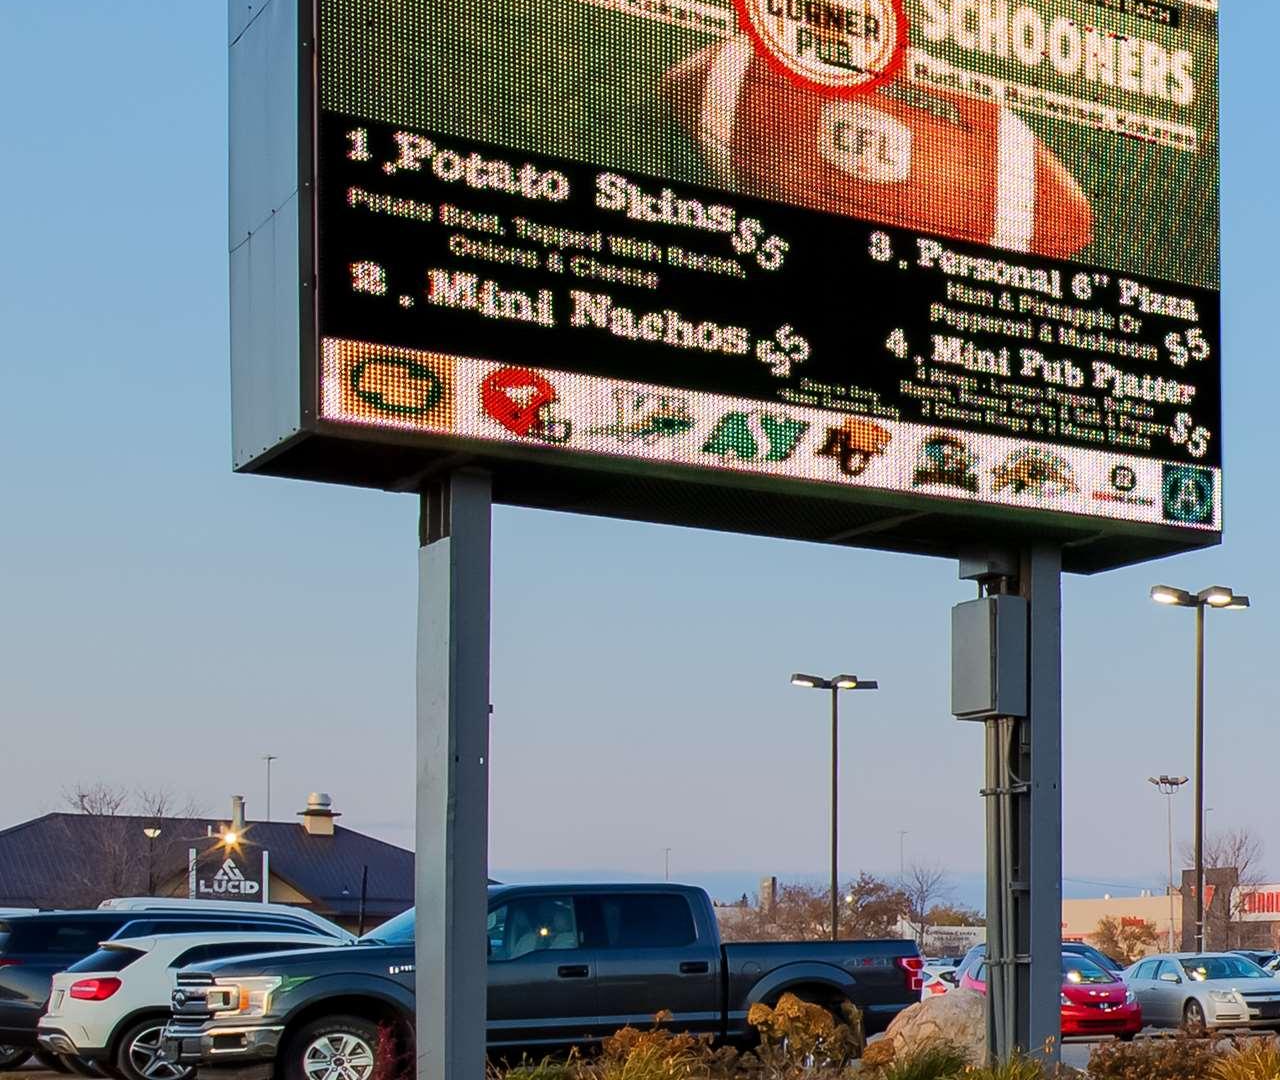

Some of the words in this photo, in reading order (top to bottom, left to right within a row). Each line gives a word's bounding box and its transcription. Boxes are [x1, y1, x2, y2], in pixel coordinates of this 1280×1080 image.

[797, 26, 852, 69] PUB
[833, 119, 897, 166] CFL
[348, 185, 432, 224] Potato
[512, 216, 601, 257] Topped
[609, 234, 662, 265] With
[397, 130, 570, 207] Potato
[594, 170, 738, 239] Skins
[731, 214, 790, 274] $5
[449, 232, 538, 270] Onions
[571, 254, 659, 291] Cheese
[916, 238, 1063, 299] Personal
[1118, 278, 1199, 323] Pizza
[428, 265, 555, 326] Mini
[570, 289, 749, 358] Nachos
[755, 319, 811, 381] $5
[930, 302, 1032, 343] Pepperoni
[1059, 325, 1158, 362] Mushroom
[947, 280, 993, 309] Ham
[1018, 294, 1114, 335] Pineapple
[1118, 312, 1143, 336] Or
[1164, 322, 1210, 373] $5
[931, 333, 1010, 377] Mini
[1020, 348, 1084, 389] Pub
[1092, 361, 1196, 410] Platter
[1170, 411, 1212, 460] $5
[200, 880, 259, 894] LUCID
